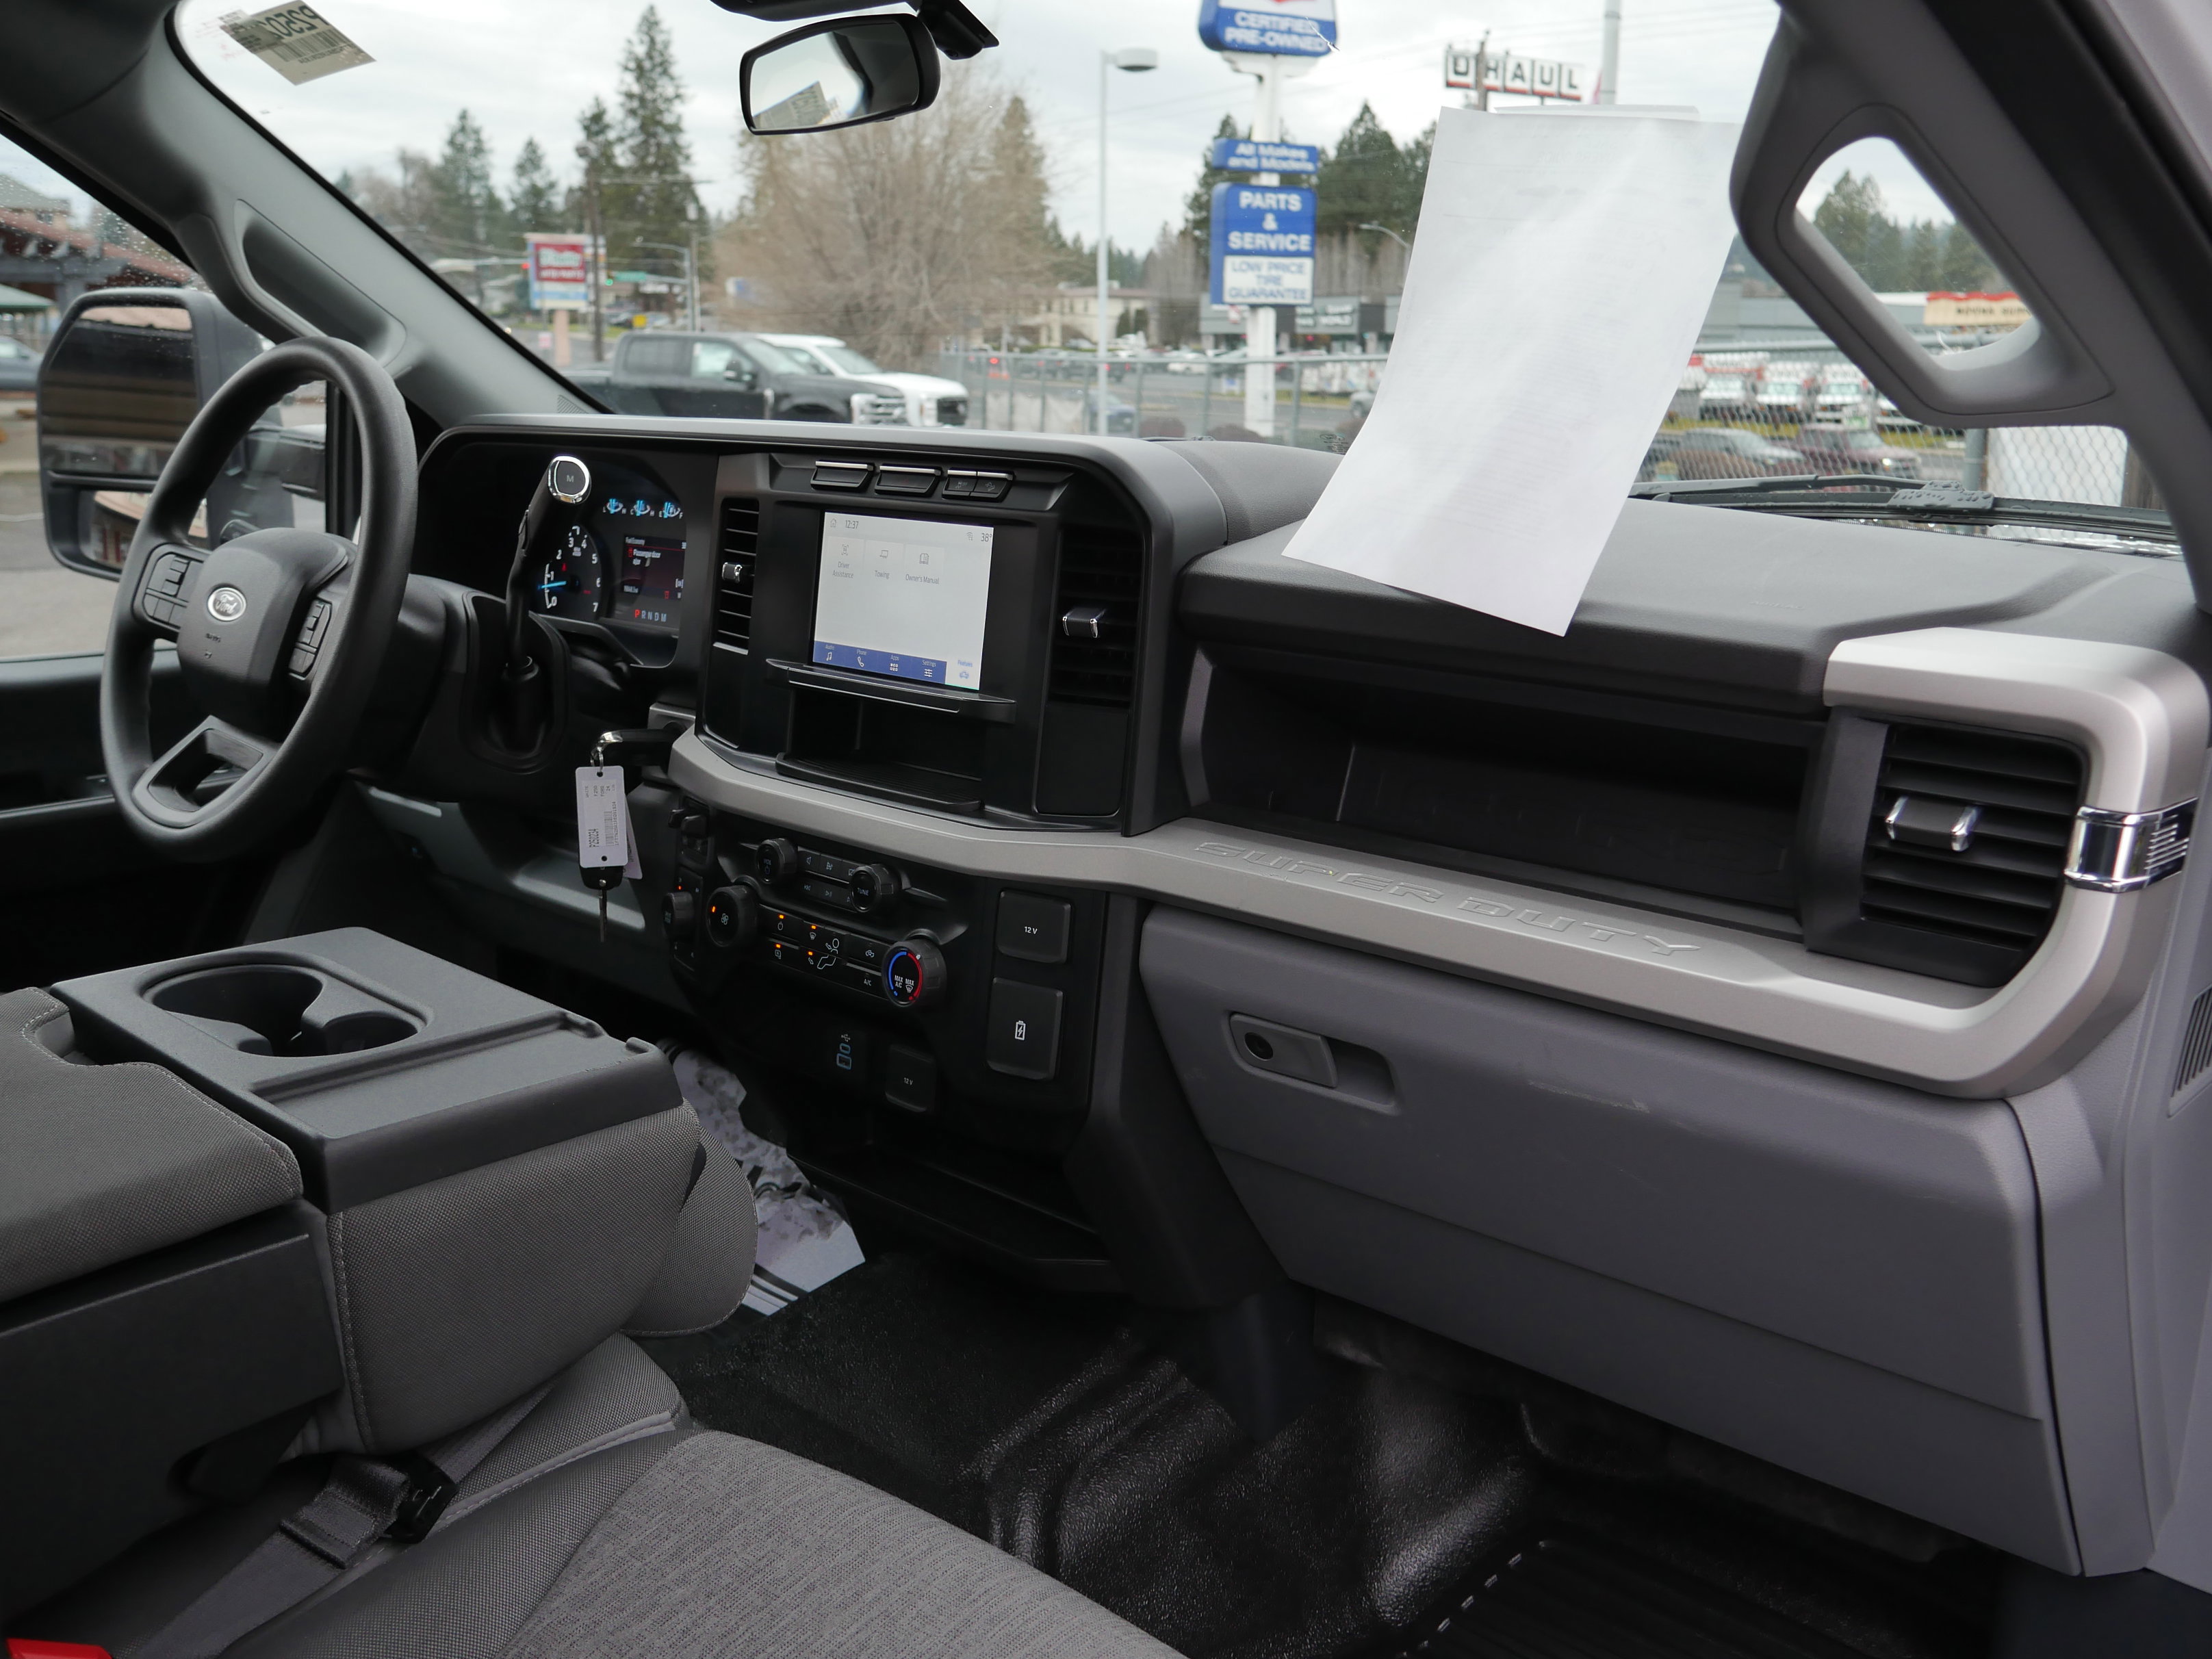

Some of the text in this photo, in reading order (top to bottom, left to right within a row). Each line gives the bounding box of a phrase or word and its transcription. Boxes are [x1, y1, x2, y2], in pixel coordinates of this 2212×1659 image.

[1239, 190, 1302, 212] PARTS
[1261, 212, 1278, 231] &
[1228, 230, 1313, 252] SERVICE
[1231, 261, 1304, 274] LOW PRICE
[1255, 274, 1283, 286] TIRE
[1229, 287, 1307, 300] GUARANTEE
[844, 519, 859, 530] 12:37
[568, 537, 574, 548] 3
[581, 539, 587, 549] 4
[556, 550, 562, 561] 2
[592, 553, 598, 565] 5
[837, 561, 850, 570] Driver
[832, 569, 854, 579] Assistance
[875, 570, 890, 580] Towing
[905, 574, 939, 584] Owner's Manual
[551, 596, 558, 606] 0
[593, 602, 599, 613] 7
[634, 610, 667, 622] P R N D M
[890, 654, 899, 663] Apps
[922, 660, 937, 669] Settings
[857, 887, 869, 896] TUNE
[1194, 840, 1701, 956] SUPER DUTY
[1024, 925, 1031, 934] 12
[863, 978, 872, 987] A/C
[894, 975, 903, 983] MAX
[905, 978, 914, 986] MAX
